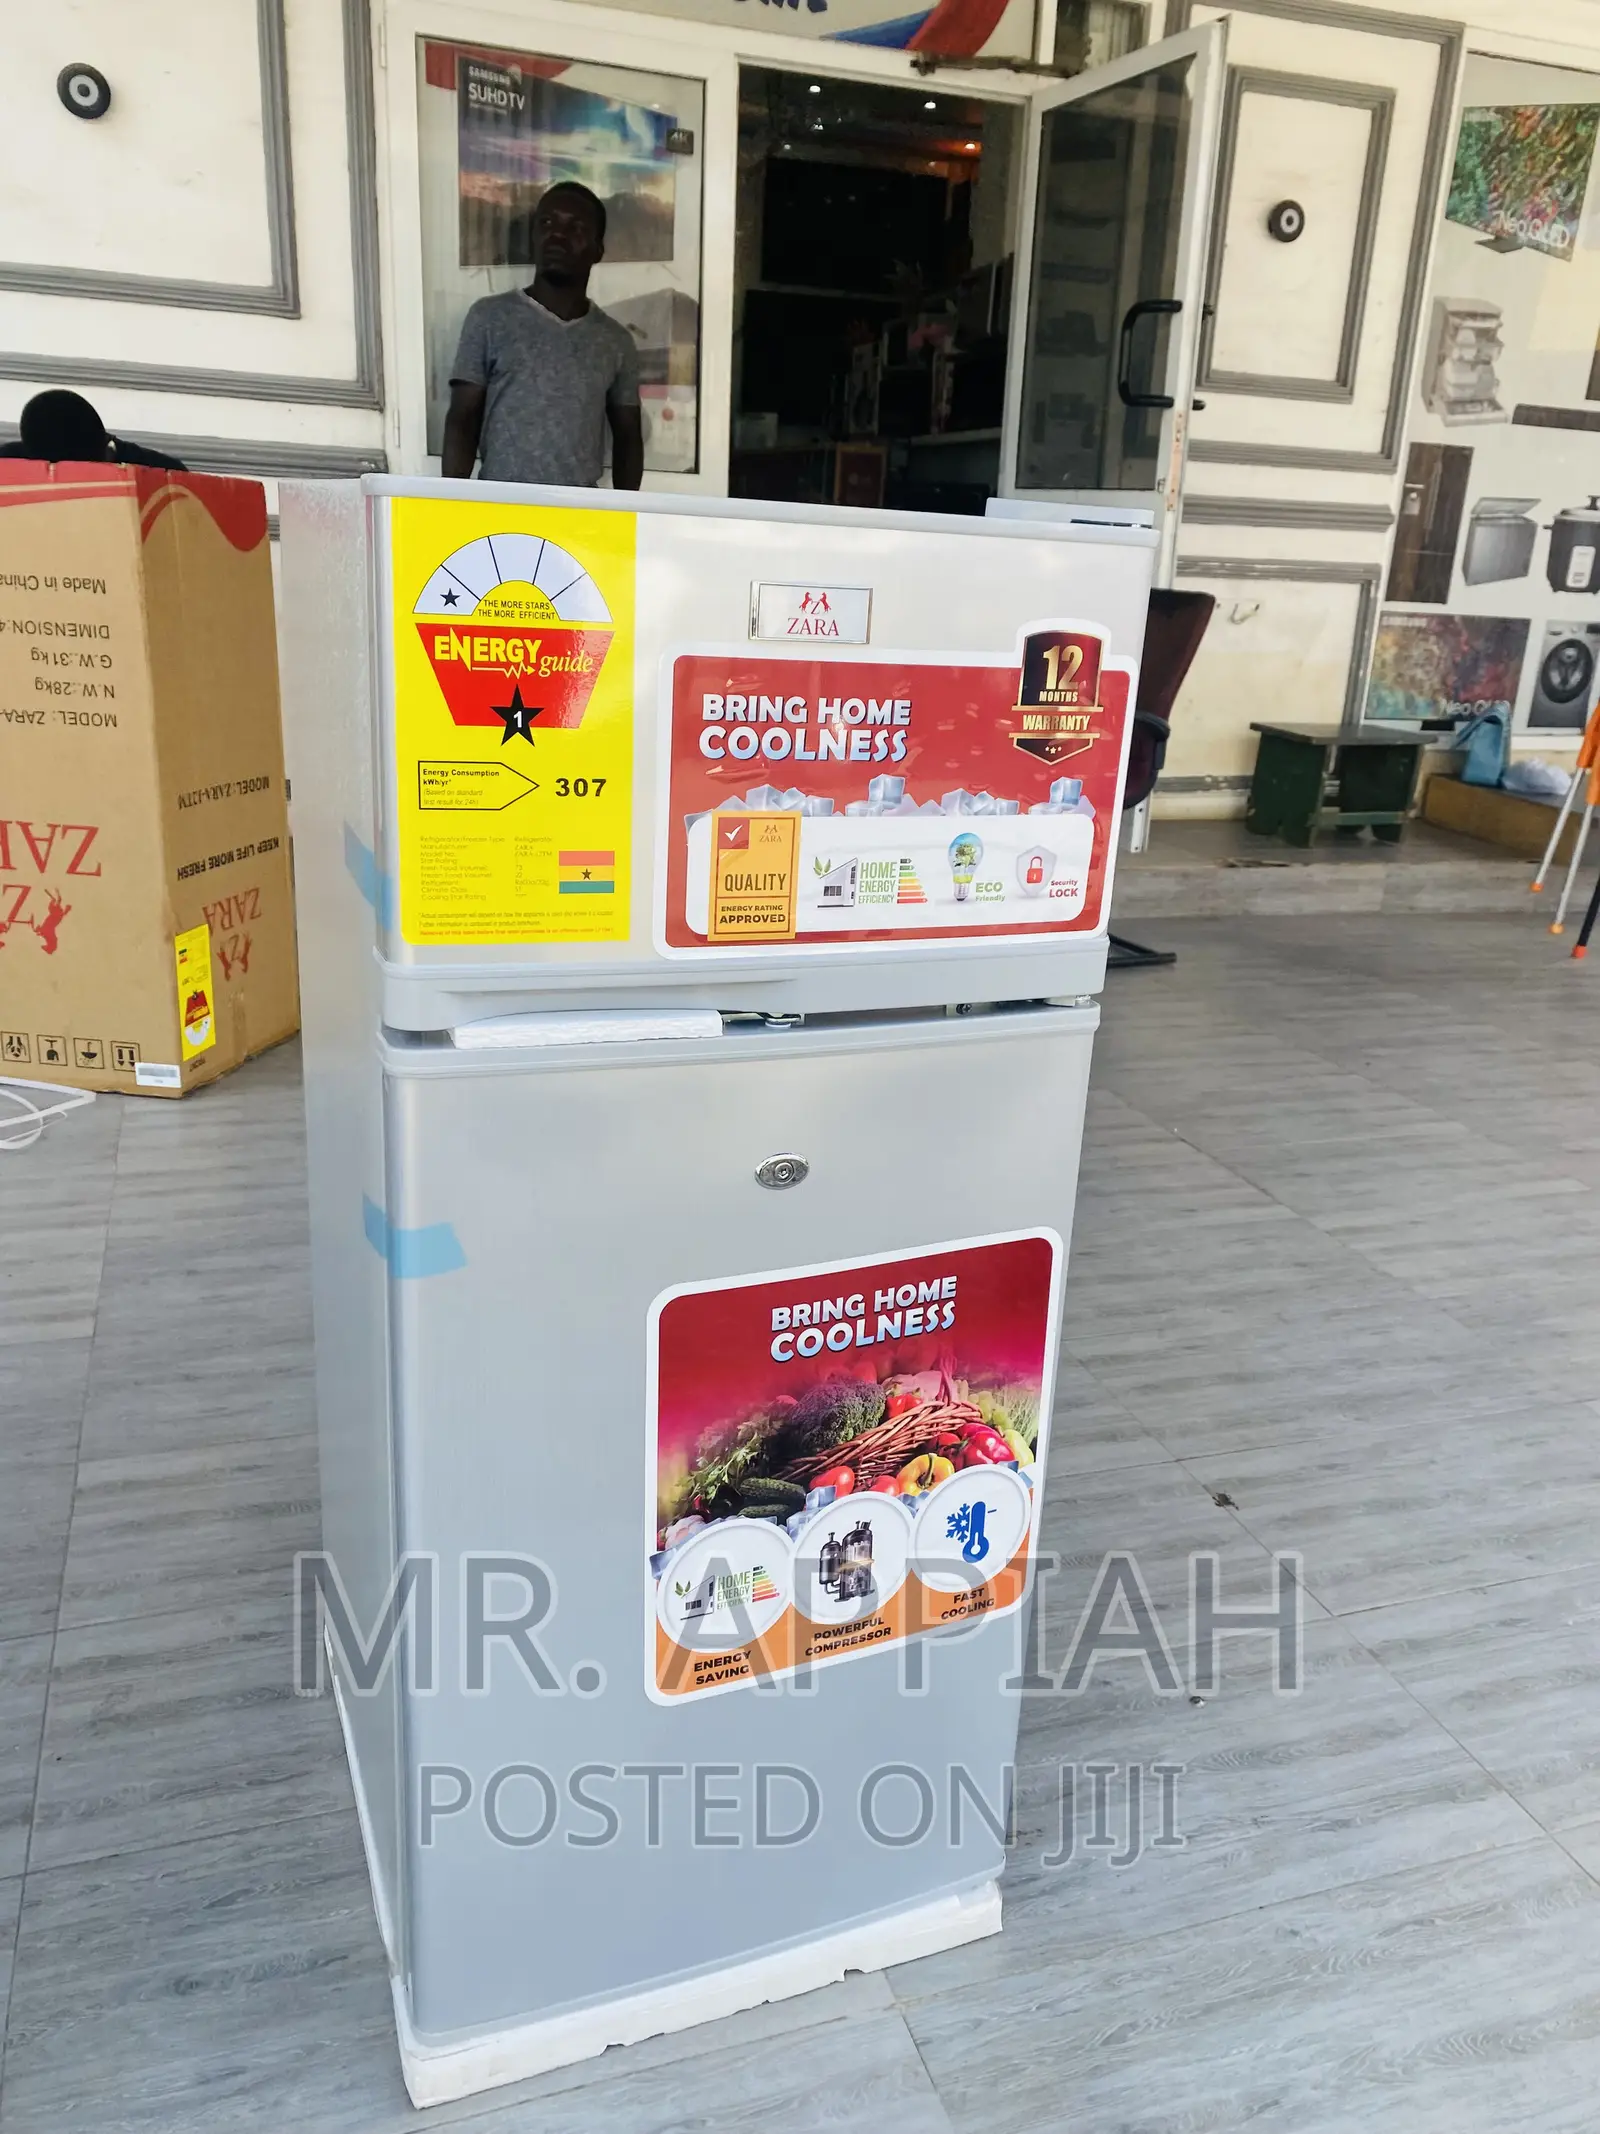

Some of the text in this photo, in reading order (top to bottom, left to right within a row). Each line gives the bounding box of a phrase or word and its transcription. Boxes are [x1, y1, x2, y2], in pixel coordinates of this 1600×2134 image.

[44, 575, 58, 592] in
[62, 576, 106, 595] Made
[483, 599, 550, 610] THE MORE STARS
[478, 609, 556, 620] THE MORE EFFICIENT
[786, 617, 840, 636] ZARA
[434, 626, 594, 677] ENERGY guide
[1043, 644, 1083, 690] 12
[1039, 691, 1079, 702] MONTHS
[702, 693, 912, 726] BRING HOME
[513, 710, 523, 728] 1
[1022, 714, 1091, 731] WARRANTY
[699, 725, 908, 763] COOLNESS
[423, 769, 500, 777] Energy Consumption
[555, 778, 607, 797] 307
[759, 835, 782, 843] ZARA
[176, 837, 280, 881] KEEP LIFE MORE FRESH
[860, 861, 898, 879] HOME
[724, 873, 787, 892] QUALITY
[859, 879, 897, 893] ENERGY
[975, 881, 1004, 893] ECO
[1050, 878, 1078, 888] Security
[858, 894, 895, 904] EFFICIENCY
[975, 894, 1006, 903] Friendly
[1049, 887, 1078, 899] LOCK
[202, 887, 262, 937] ZARA
[719, 914, 786, 924] APPROVED
[771, 1275, 958, 1332] BRING HOME
[770, 1300, 956, 1363] COOLNESS
[717, 1570, 751, 1590] HOME
[717, 1585, 750, 1602] ENERGY
[953, 1587, 985, 1604] FAST
[941, 1598, 995, 1620] COOLING
[813, 1617, 885, 1641] POWERFUL
[805, 1626, 892, 1656] COMPRESSOR
[694, 1650, 752, 1673] ENERGY
[695, 1665, 749, 1685] SAVING
